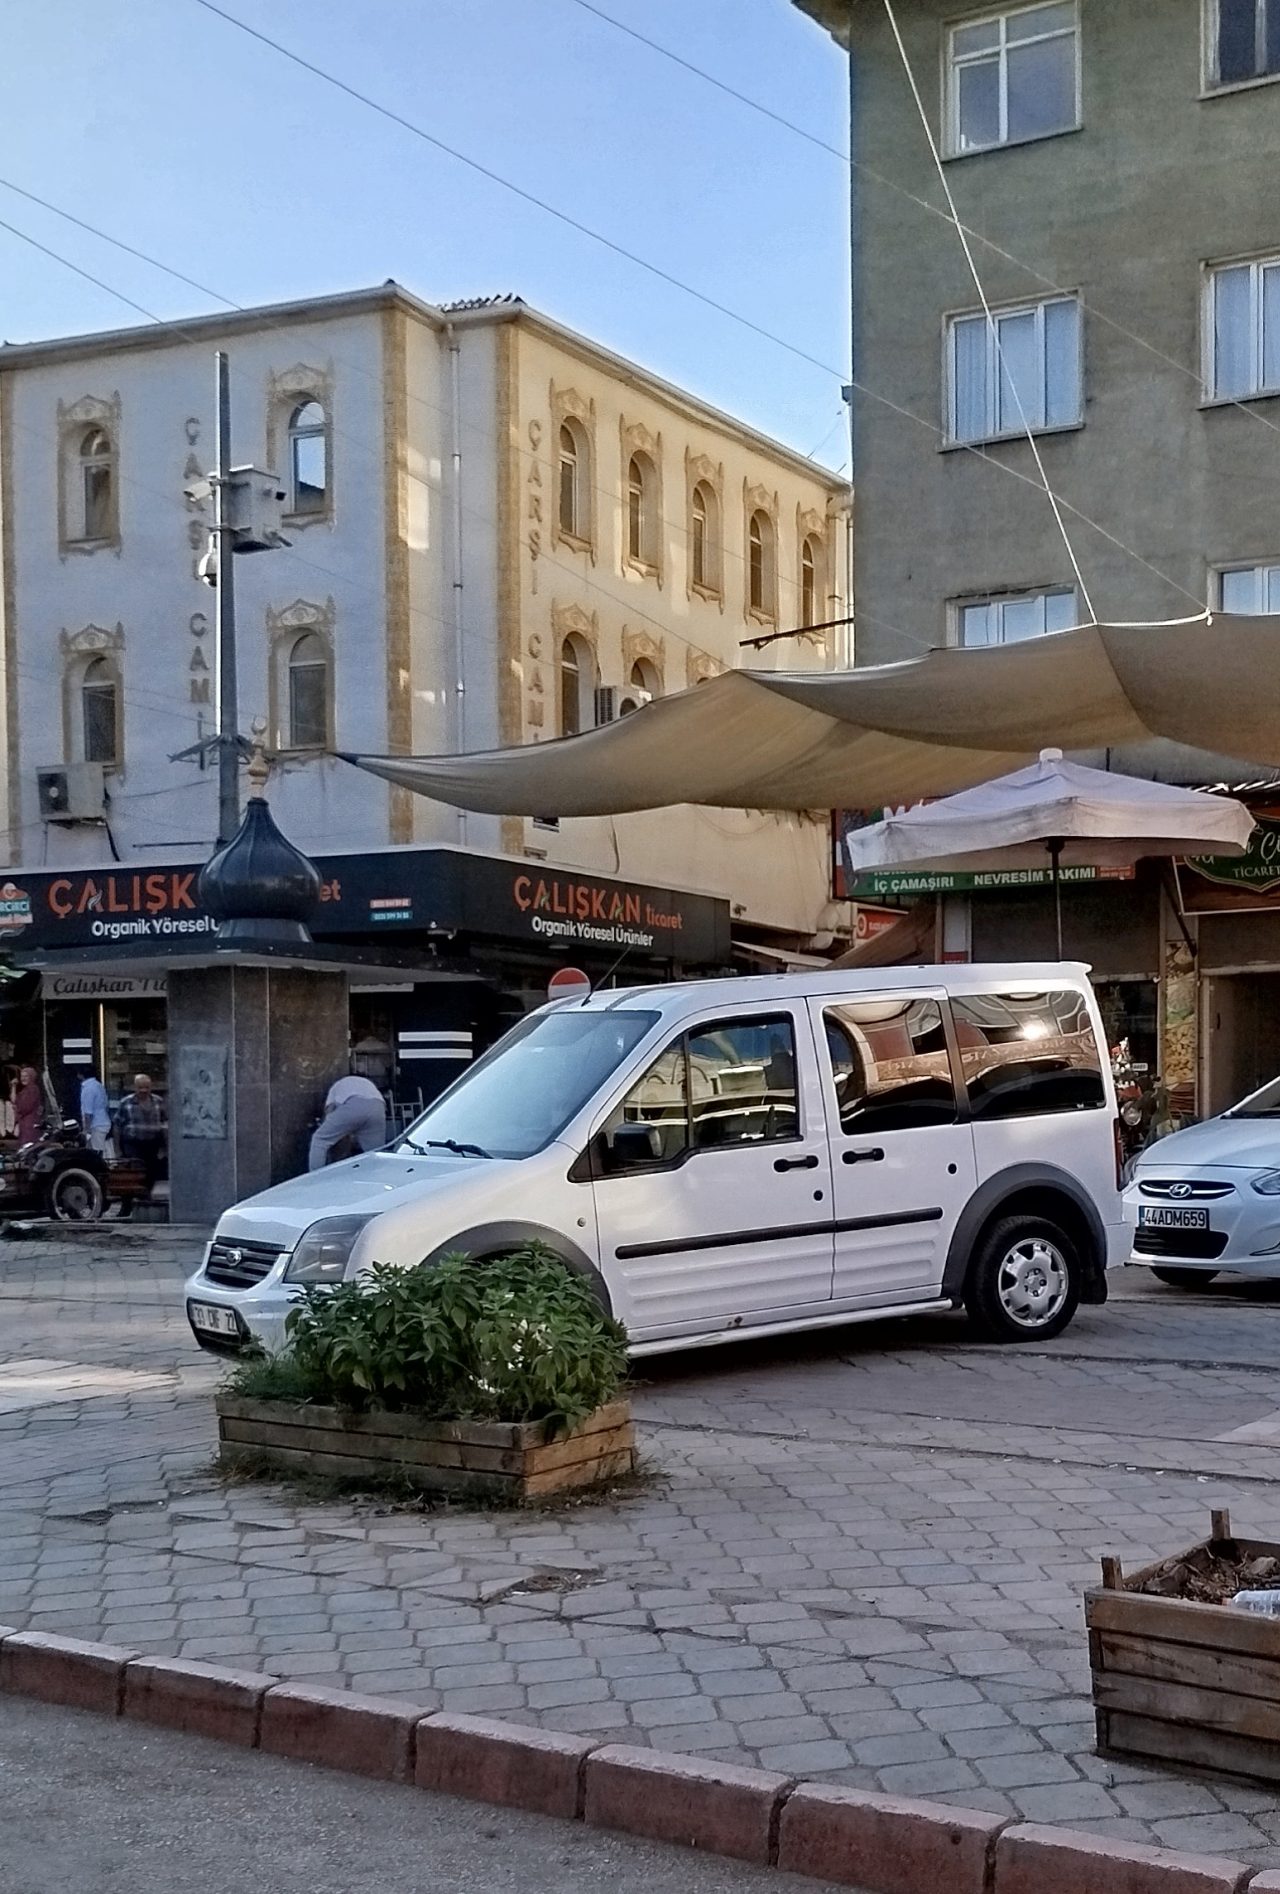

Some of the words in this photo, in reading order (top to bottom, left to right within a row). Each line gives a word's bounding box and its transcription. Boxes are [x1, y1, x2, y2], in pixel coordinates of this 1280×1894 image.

[874, 879, 888, 893] İÇ
[891, 877, 954, 893] ÇAMAŞIRI
[974, 870, 1043, 886] NEVRESİM
[1046, 867, 1096, 881] TAKIMI
[49, 873, 198, 919] ÇALIŞK
[513, 875, 641, 924] ÇALIŞKAN
[646, 903, 682, 930] ticaret
[91, 918, 151, 939] Organik
[151, 915, 209, 935] Yöresel
[531, 916, 576, 937] Organik
[577, 922, 615, 943] Yöresel
[615, 924, 653, 947] Ürünler
[53, 977, 136, 995] Çalışkan
[1145, 1209, 1206, 1228] 44ADM659
